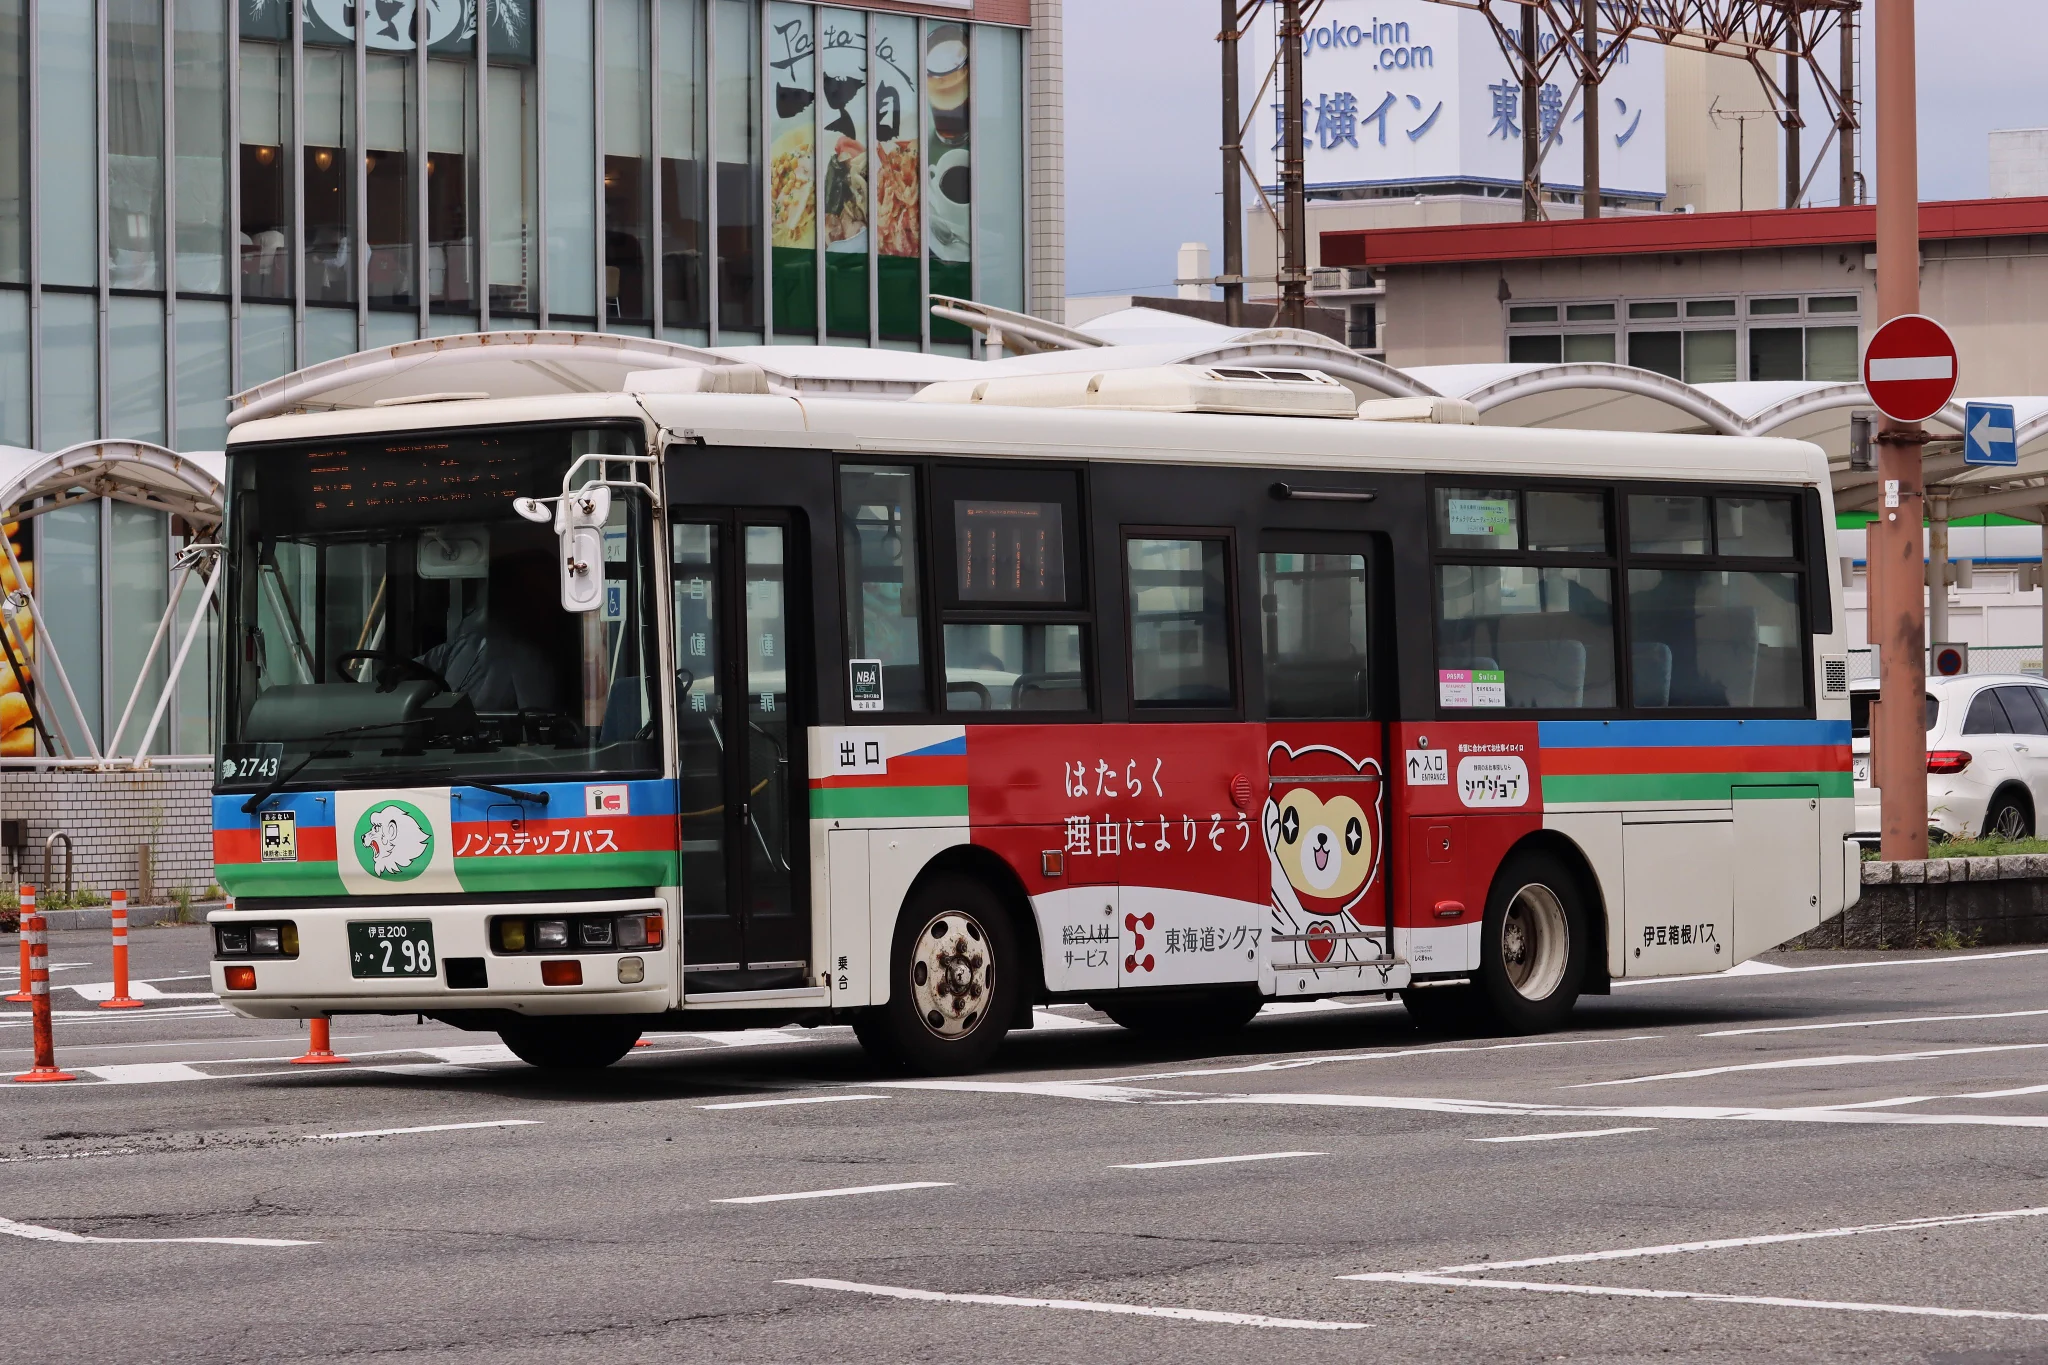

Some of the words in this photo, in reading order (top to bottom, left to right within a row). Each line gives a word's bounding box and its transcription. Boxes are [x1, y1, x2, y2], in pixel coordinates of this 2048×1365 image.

[1280, 17, 1410, 58] yoko-inn
[1373, 45, 1433, 70] .com
[856, 671, 876, 683] NBA
[1478, 672, 1497, 681] Suica
[840, 740, 880, 767] 出口
[1423, 756, 1443, 771] 入口
[238, 757, 278, 777] 2743
[1064, 757, 1163, 798] はたらく
[1421, 773, 1446, 782] ENTRANCE
[1465, 774, 1521, 801] シグジョブ
[265, 813, 290, 821] あぶない
[456, 828, 619, 856] ノンステップバス
[1063, 811, 1251, 857] 理由によりそう
[1062, 923, 1110, 946] 総合人材
[1164, 924, 1263, 955] 東海道シグマ
[1643, 923, 1716, 948] 伊豆箱根バス
[354, 951, 363, 963] か
[1064, 948, 1109, 969] サービス
[837, 955, 849, 991] 乗合
